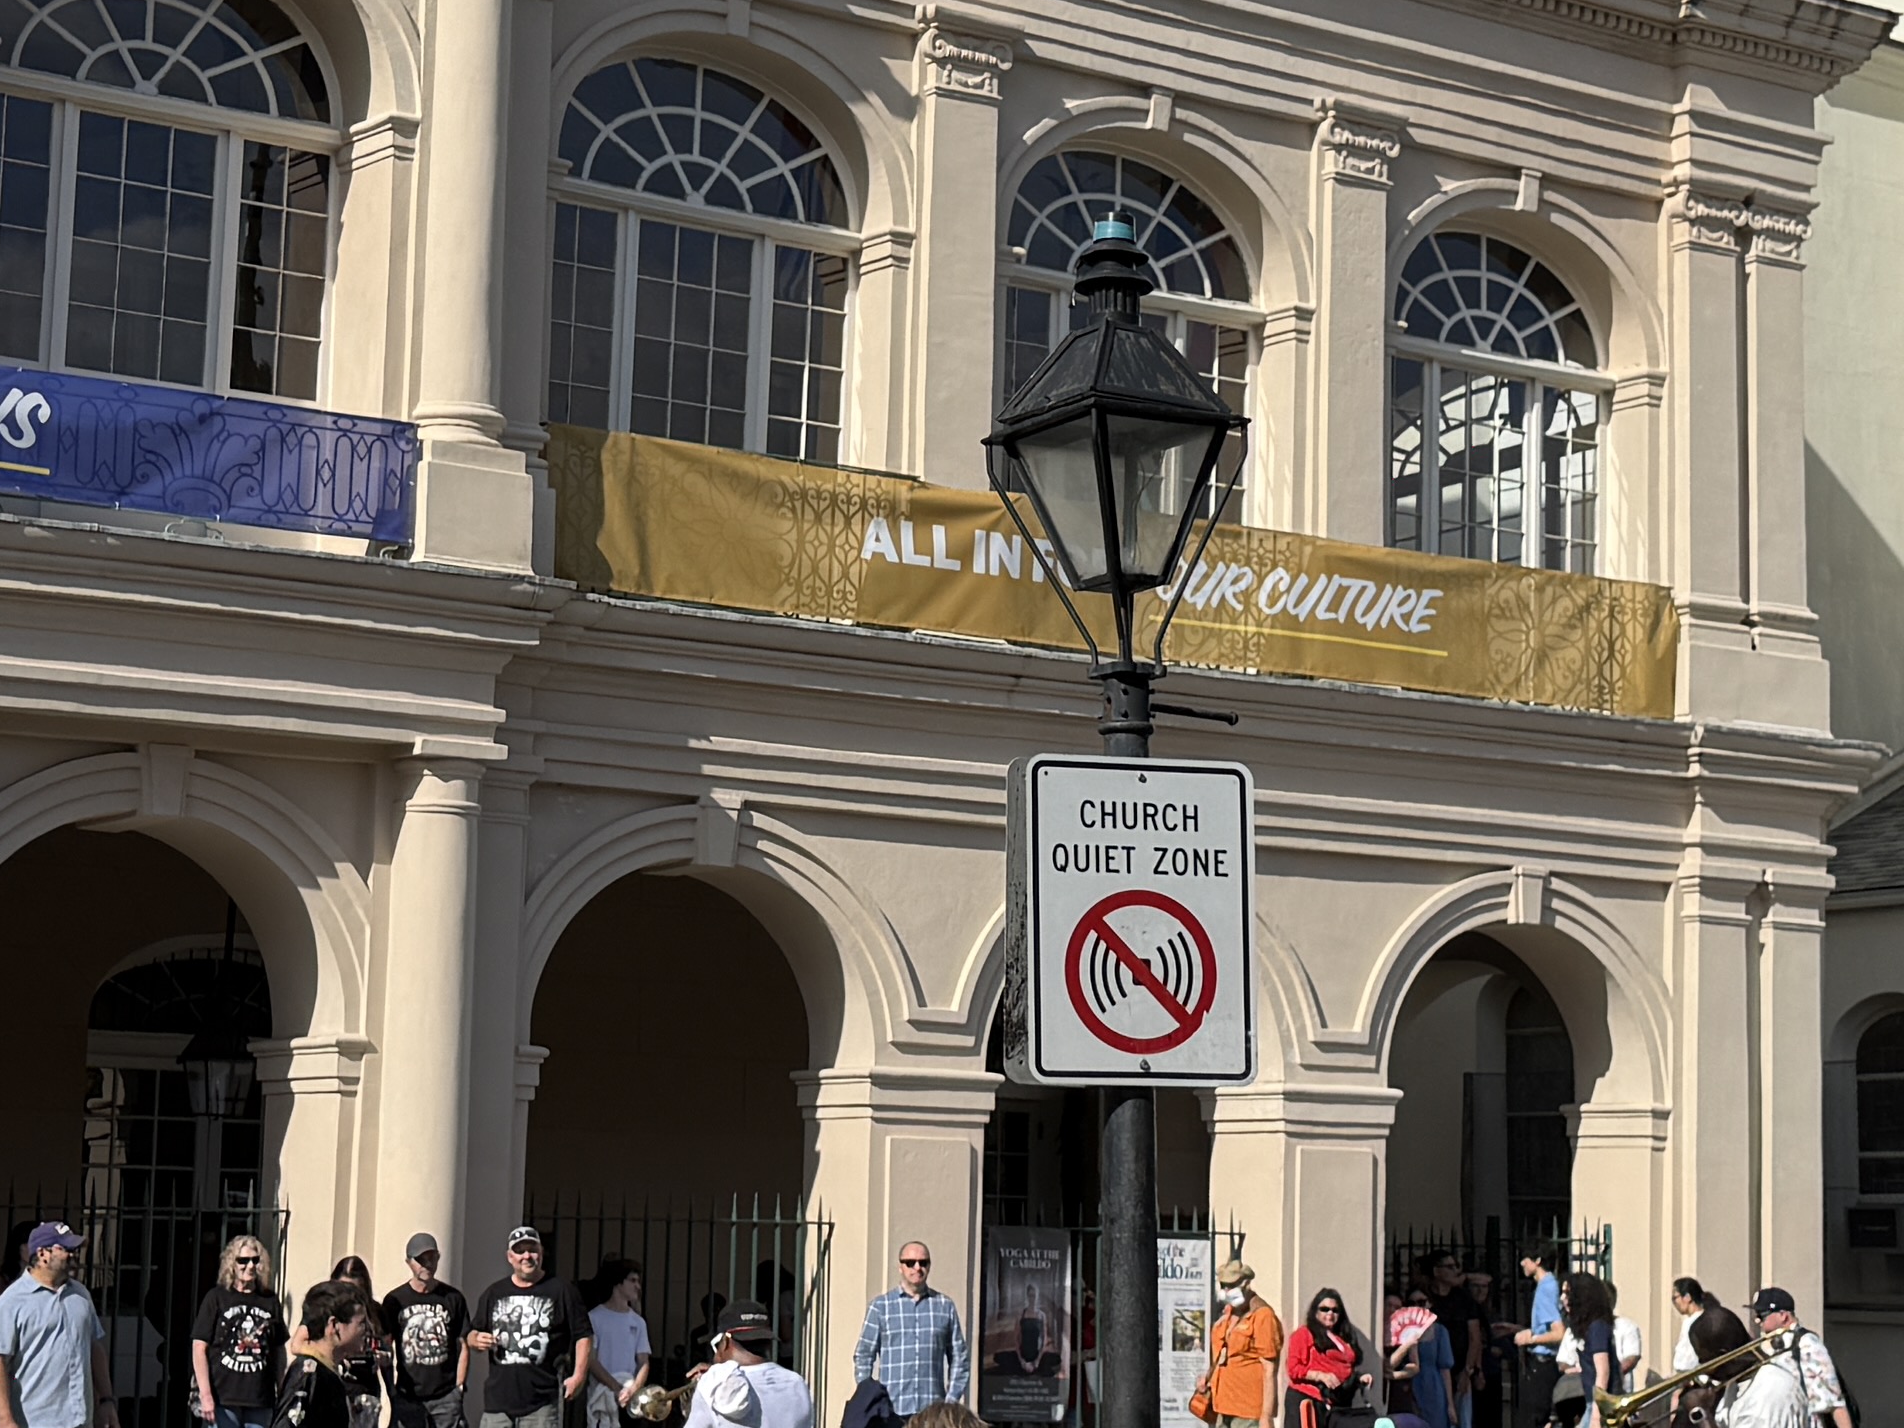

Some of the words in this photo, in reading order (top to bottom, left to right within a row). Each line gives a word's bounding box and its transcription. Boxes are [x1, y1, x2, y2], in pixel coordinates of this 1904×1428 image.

[860, 515, 961, 571] ALL
[972, 529, 1022, 579] IN
[1155, 553, 1253, 612] OUR
[1256, 566, 1444, 634] CULTURE
[1079, 799, 1200, 833] CHURCH
[1052, 843, 1137, 876] QUIET
[1152, 846, 1230, 879] ZONE
[999, 1247, 1029, 1258] YOGA
